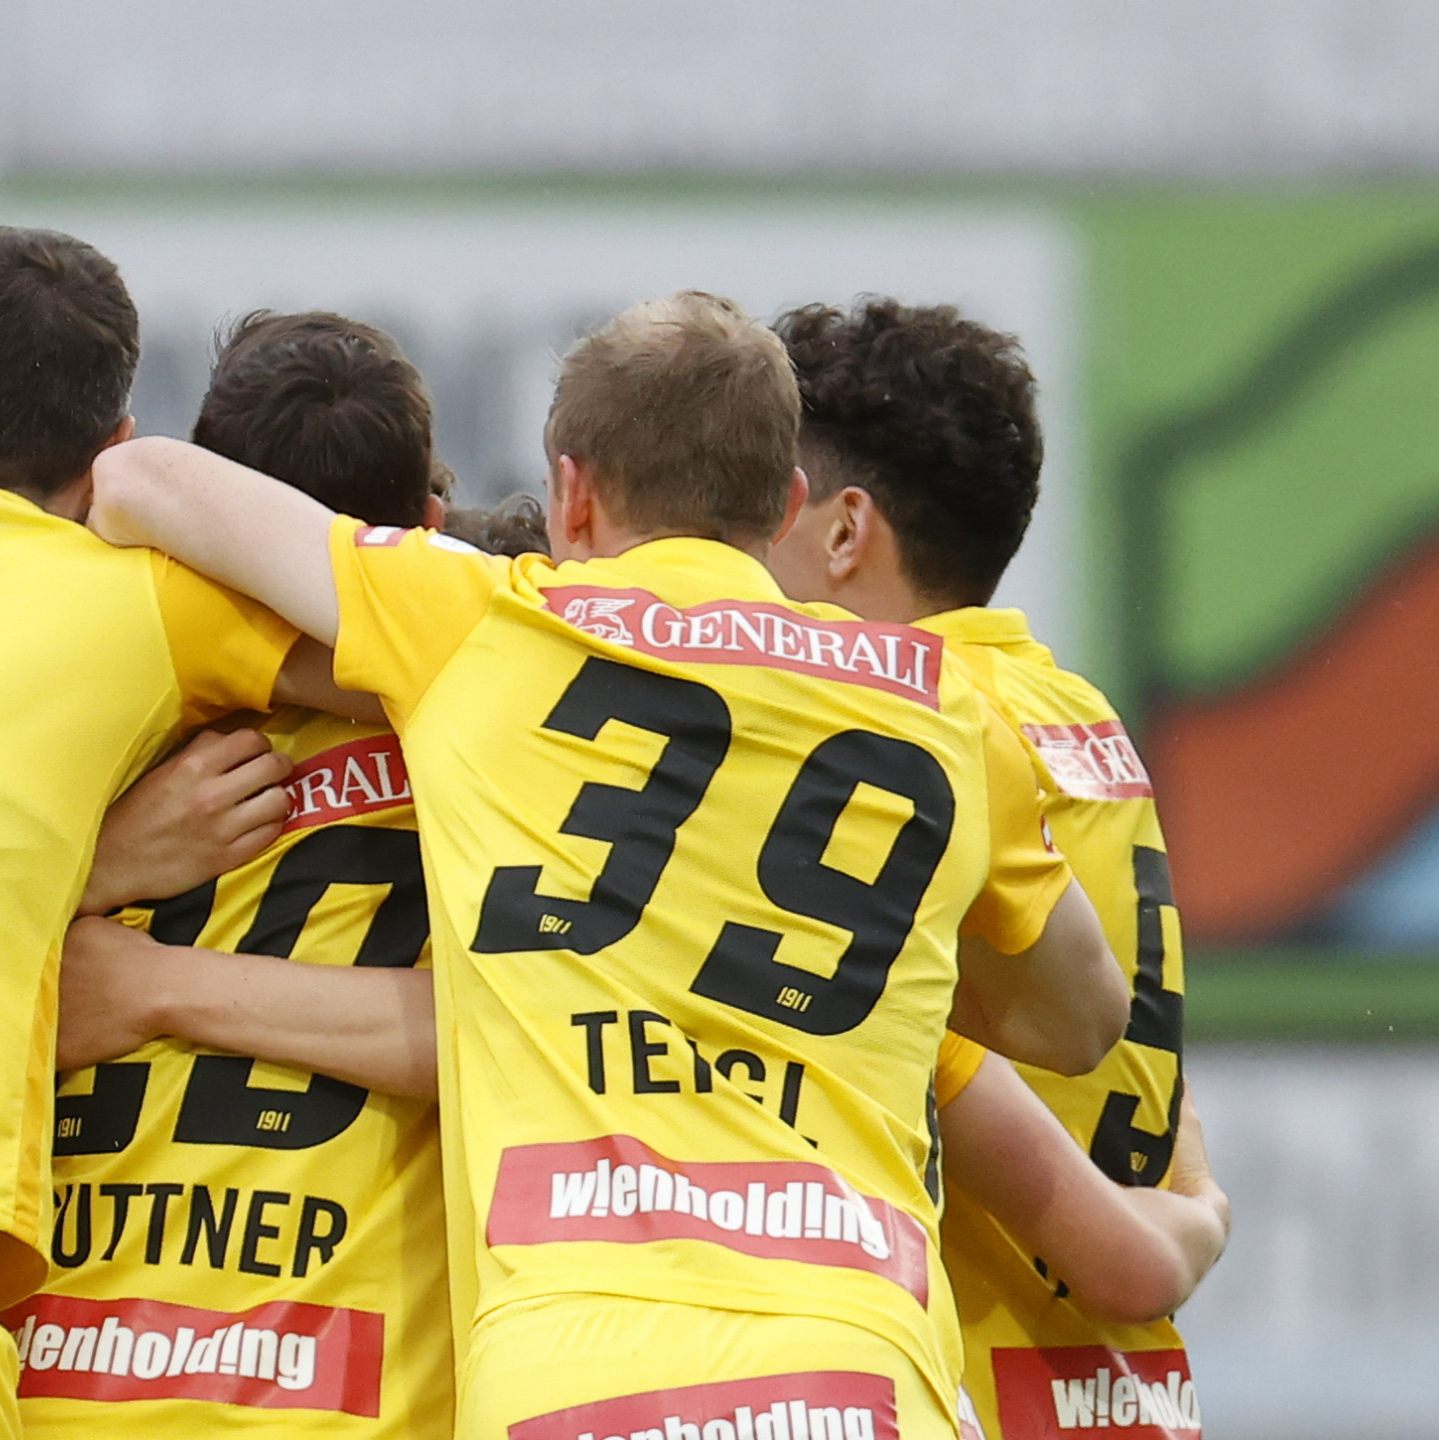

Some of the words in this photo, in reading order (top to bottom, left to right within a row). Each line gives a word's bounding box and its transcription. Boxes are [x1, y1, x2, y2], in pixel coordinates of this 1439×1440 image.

[642, 606, 930, 694] GENERALI
[470, 656, 956, 1036] 39
[775, 985, 812, 1013] 1911
[256, 1110, 292, 1132] 1911
[51, 1183, 348, 1278] UTTNER
